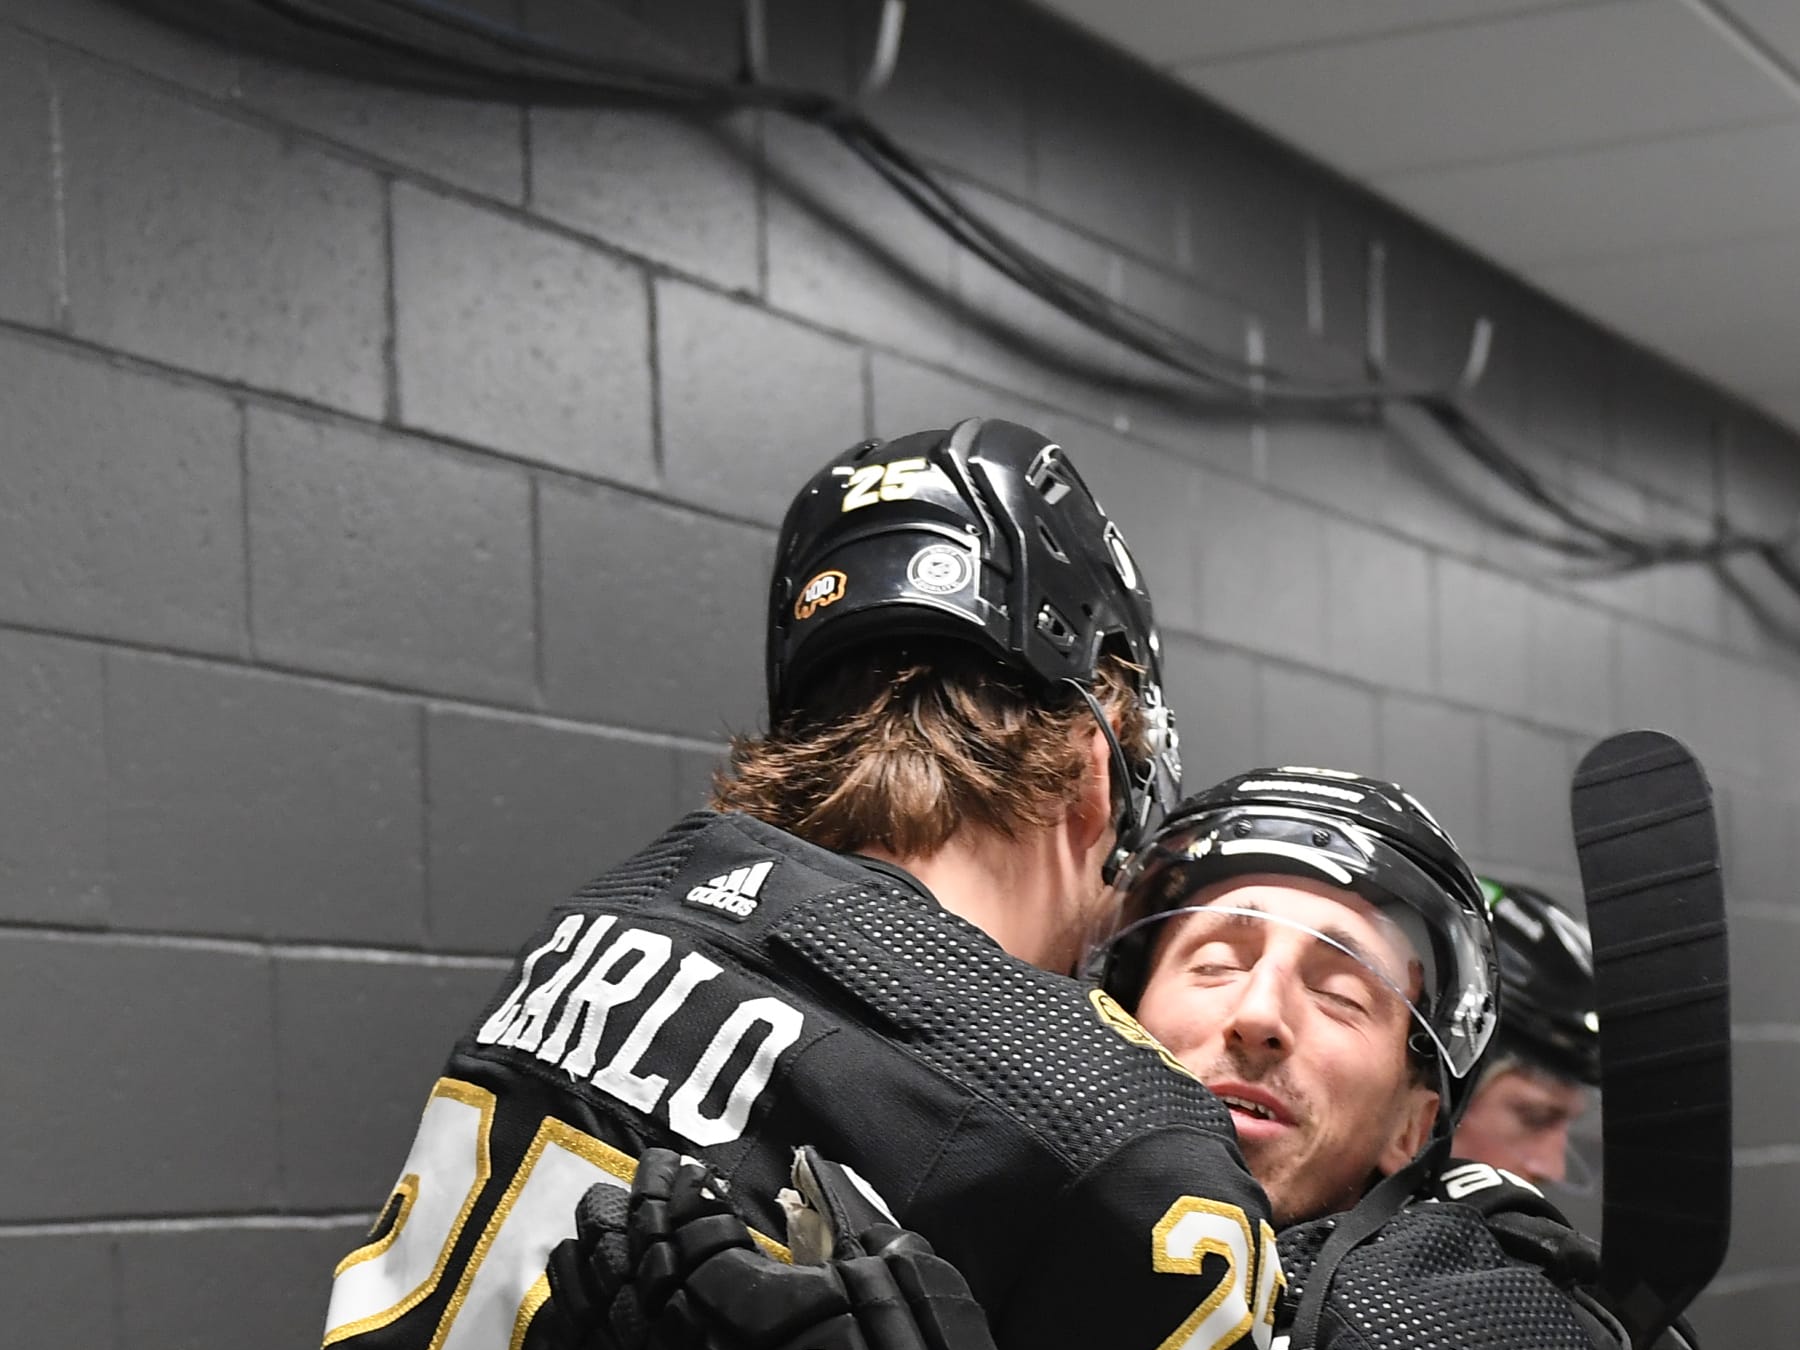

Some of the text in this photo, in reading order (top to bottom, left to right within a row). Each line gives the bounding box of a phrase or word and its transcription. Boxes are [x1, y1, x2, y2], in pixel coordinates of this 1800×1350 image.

[842, 456, 927, 513] 25
[686, 886, 758, 917] adidas
[476, 914, 804, 1146] CARLO
